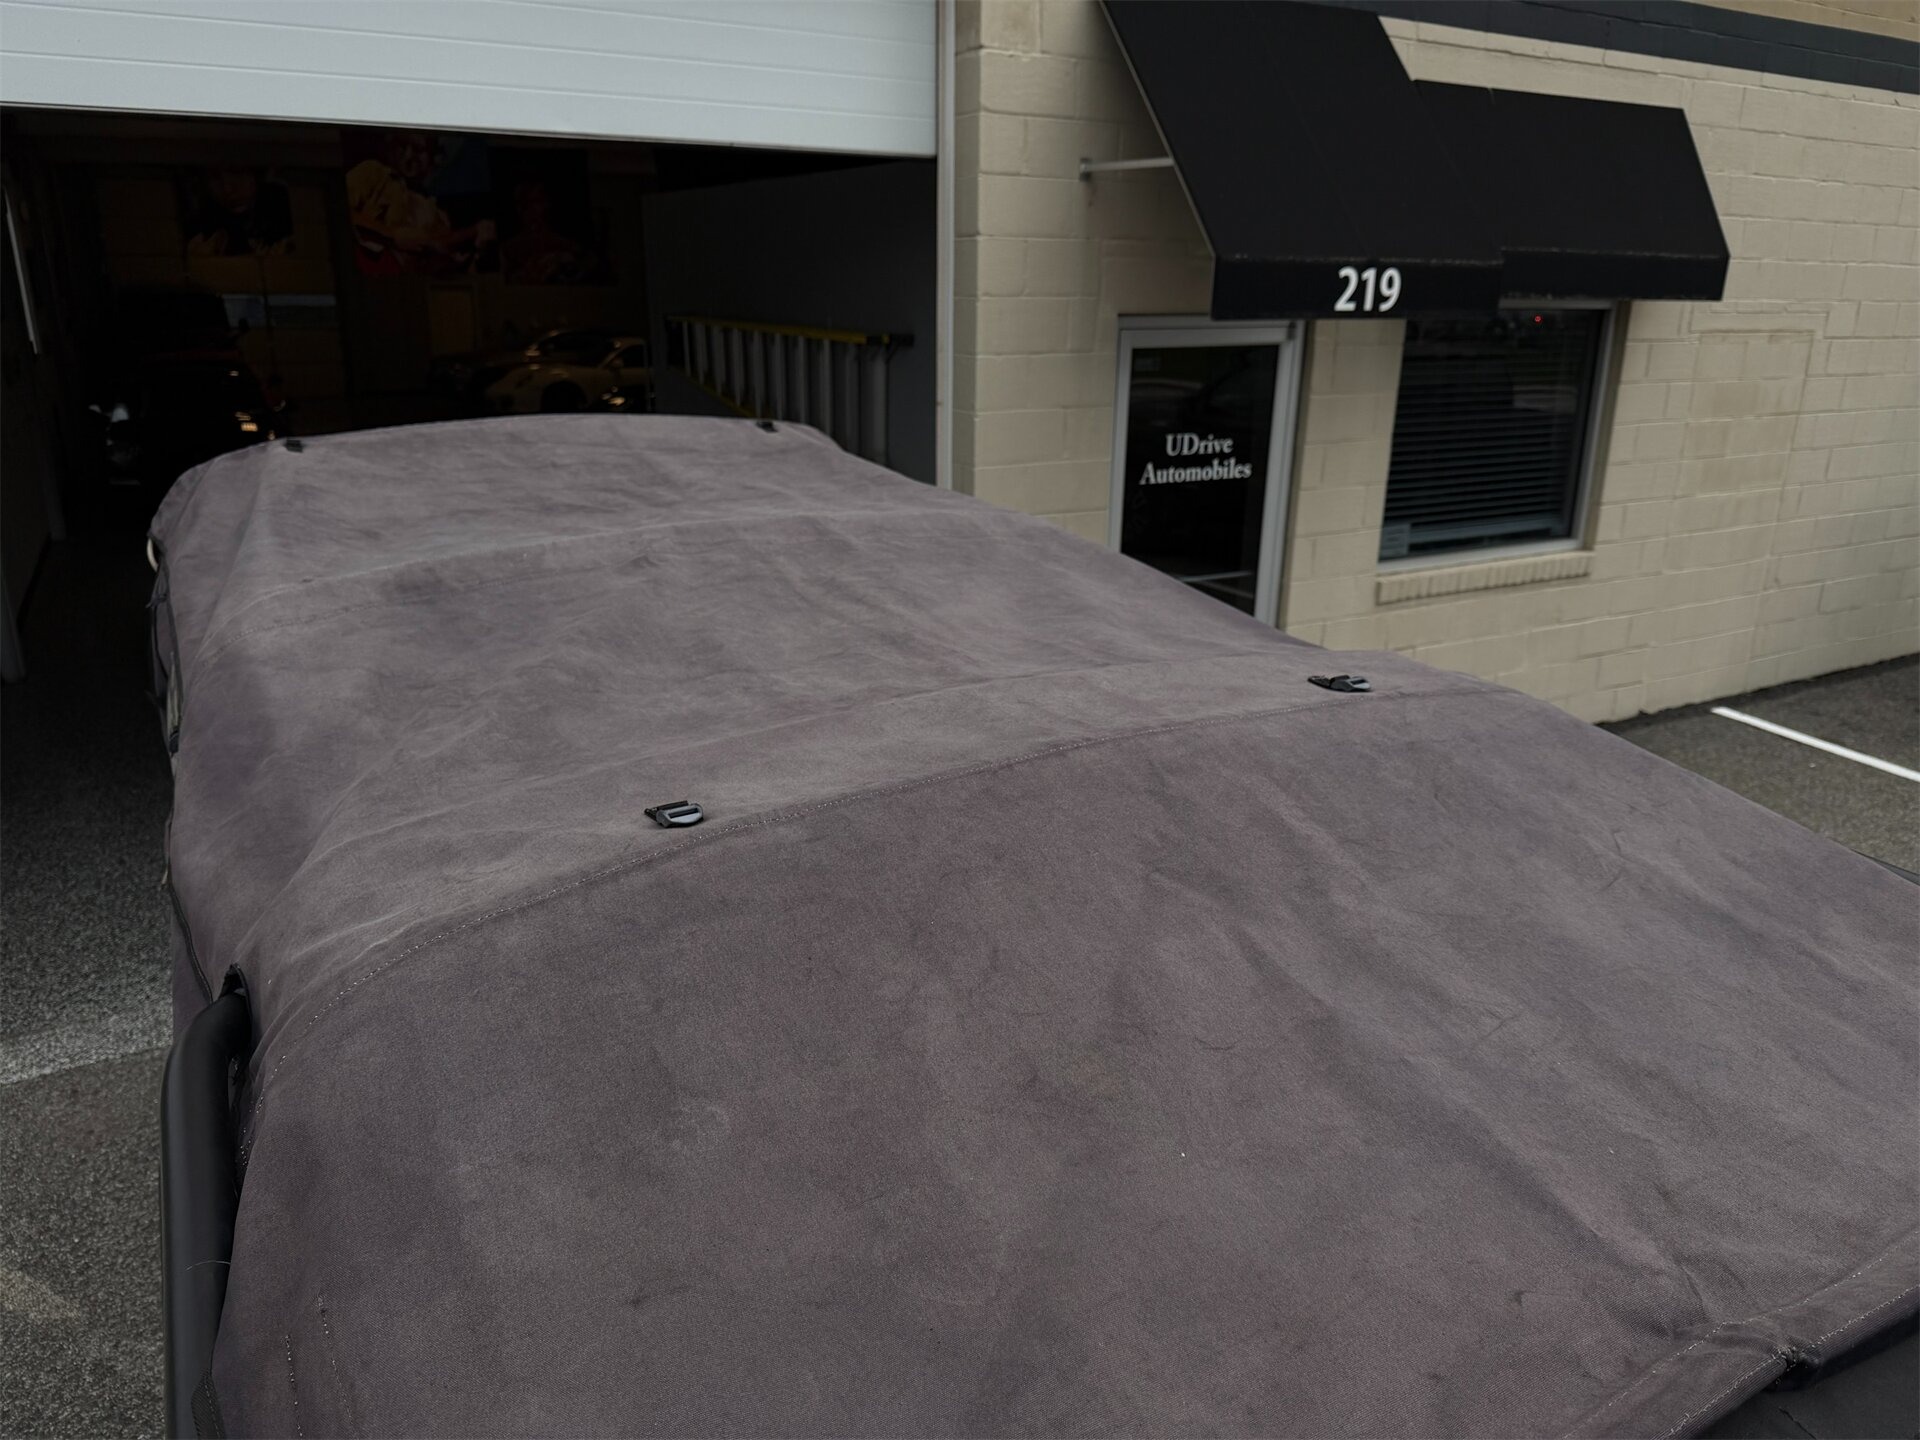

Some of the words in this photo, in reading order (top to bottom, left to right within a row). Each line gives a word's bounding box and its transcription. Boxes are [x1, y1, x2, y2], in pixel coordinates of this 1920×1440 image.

[1333, 266, 1402, 312] 219
[1166, 433, 1233, 456] UDrive
[1140, 459, 1252, 485] Automobiles
